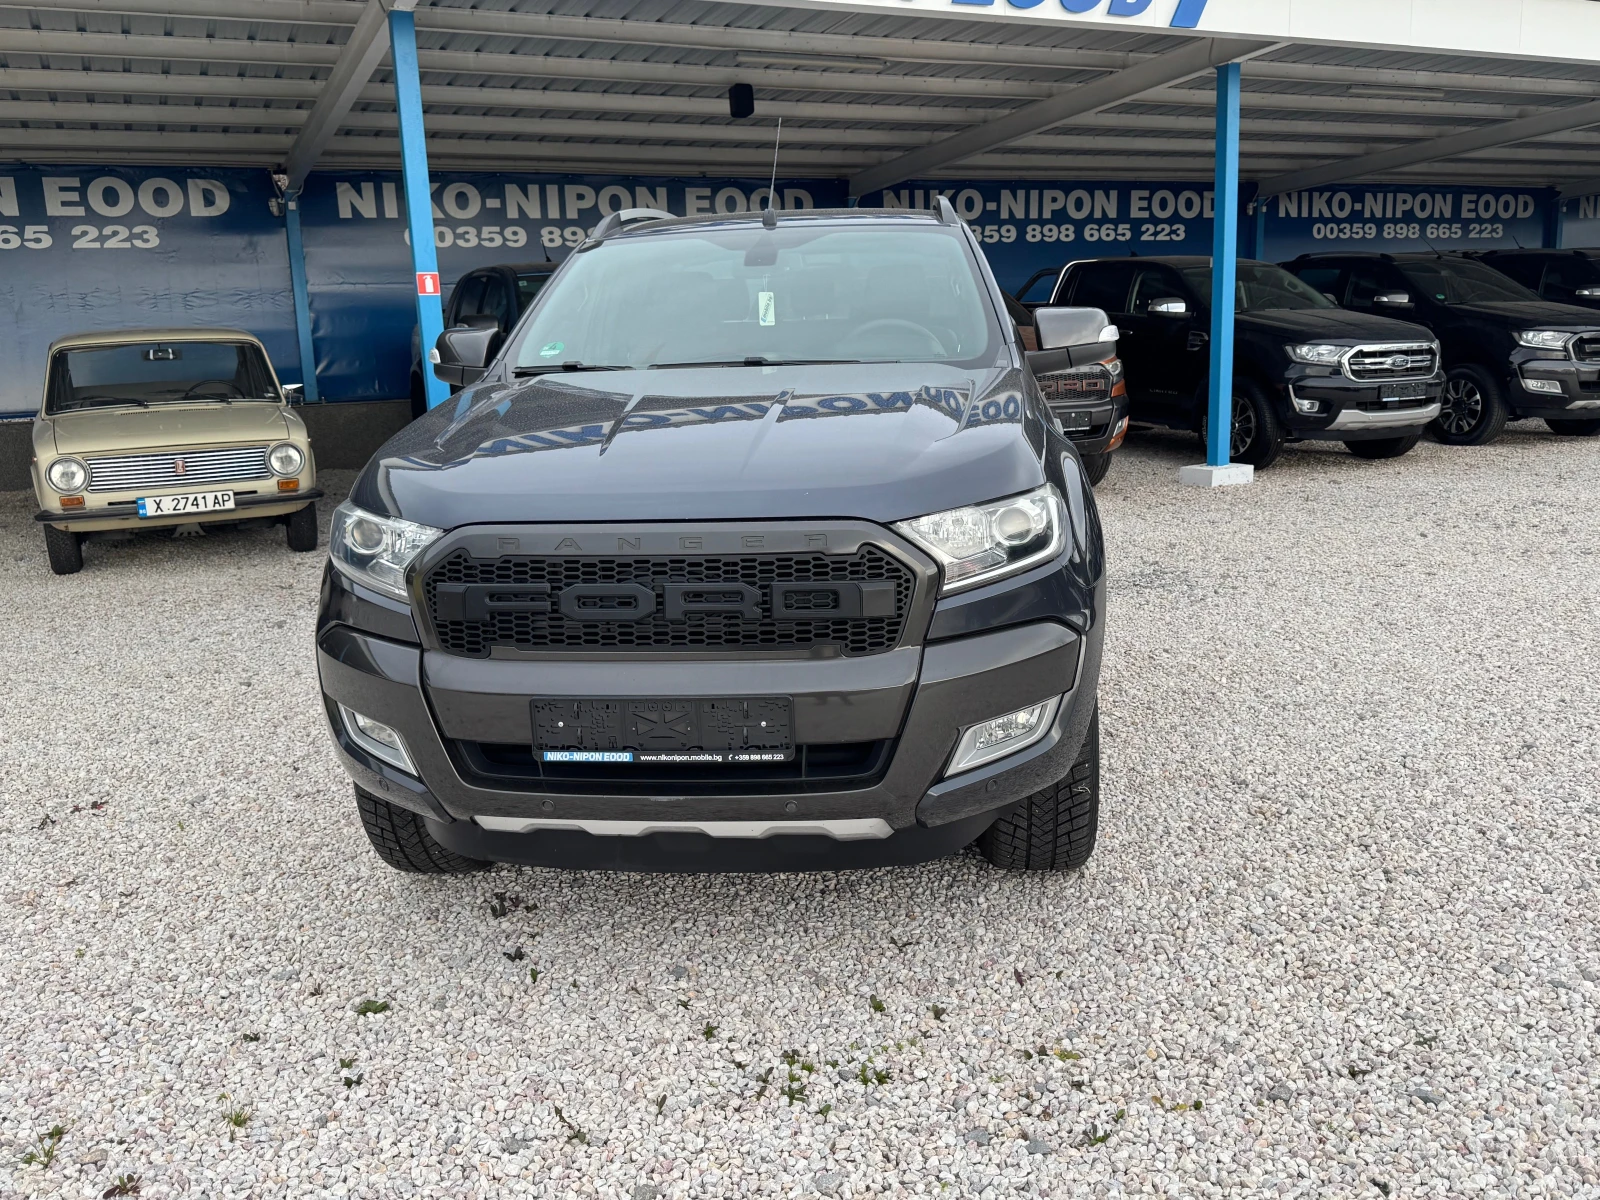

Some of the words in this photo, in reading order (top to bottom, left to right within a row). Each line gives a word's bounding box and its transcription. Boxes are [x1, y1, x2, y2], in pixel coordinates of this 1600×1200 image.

[42, 177, 231, 217] EOOD
[685, 187, 814, 217] EOOD
[1278, 191, 1452, 219] NIKO-NIPON
[1461, 194, 1535, 218] EOOD
[71, 225, 160, 249] 223
[404, 226, 527, 248] 0359
[541, 226, 597, 248] 89
[1026, 224, 1075, 242] 898
[1084, 224, 1132, 241] 665
[1140, 224, 1186, 241] 223
[1312, 223, 1377, 239] 00359
[1383, 223, 1420, 239] 898
[1426, 223, 1462, 239] 665
[1468, 223, 1504, 238] 223
[171, 495, 207, 512] 2741
[213, 493, 231, 508] AP
[498, 533, 828, 550] RANGER
[464, 580, 863, 622] FORD
[546, 751, 602, 761] NIKO-NIPON
[604, 752, 630, 761] EOOD
[639, 754, 723, 762] www.nikonipon.mobile.bg
